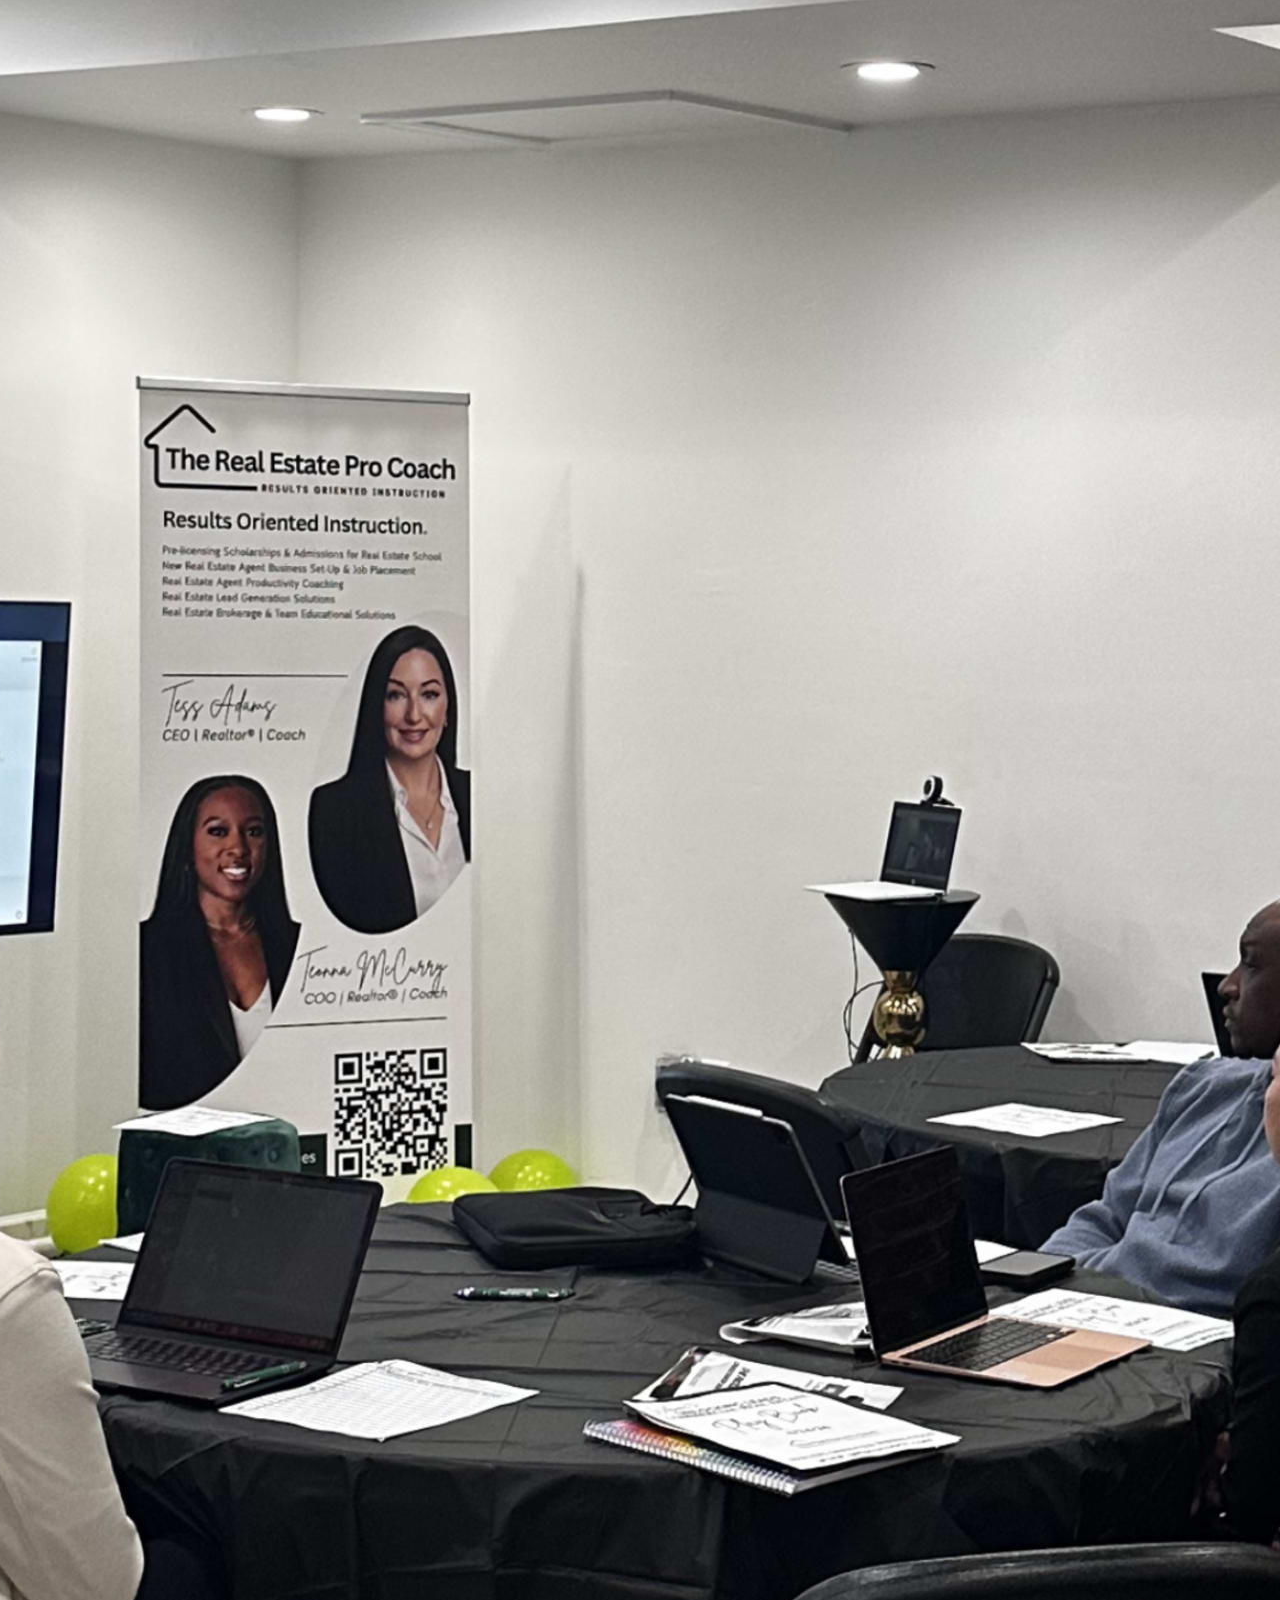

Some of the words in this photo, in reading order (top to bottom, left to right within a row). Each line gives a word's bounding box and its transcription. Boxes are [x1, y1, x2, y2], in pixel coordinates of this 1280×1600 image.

[165, 447, 210, 471] The
[215, 450, 265, 474] Real
[270, 452, 340, 476] Estate
[345, 455, 382, 478] Pro
[387, 457, 456, 480] Coach
[261, 483, 309, 494] RESULTS
[313, 485, 368, 496] ORIENTED
[372, 487, 446, 498] INSTRUCTION
[163, 510, 233, 530] Results
[236, 512, 319, 532] Oriented
[324, 514, 428, 535] Instruction.
[346, 549, 359, 559] for
[361, 549, 380, 560] Real
[382, 550, 410, 561] Estate
[412, 551, 442, 561] School
[184, 561, 205, 571] Real
[207, 562, 236, 572] Estate
[239, 563, 266, 574] Agent
[268, 563, 308, 573] Business
[370, 565, 416, 576] Placement
[162, 576, 182, 586] Real
[184, 576, 214, 587] Estate
[216, 577, 243, 588] Agent
[246, 578, 300, 590] Productivity
[302, 580, 344, 591] Coaching
[162, 591, 182, 601] Real
[184, 591, 214, 602] Estate
[216, 592, 238, 602] Lead
[241, 593, 291, 603] Generation
[294, 594, 335, 604] Solutions
[162, 607, 182, 617] Real
[184, 607, 214, 617] Estate
[216, 607, 263, 620] Brokerage
[275, 608, 299, 619] Team
[301, 609, 353, 619] Educational
[355, 609, 396, 620] Solutions
[161, 679, 205, 727] Tess
[209, 683, 278, 727] Adams
[162, 729, 190, 742] CEO
[266, 729, 306, 741] Coach
[304, 991, 337, 1005] COO
[409, 986, 448, 1001] Coach
